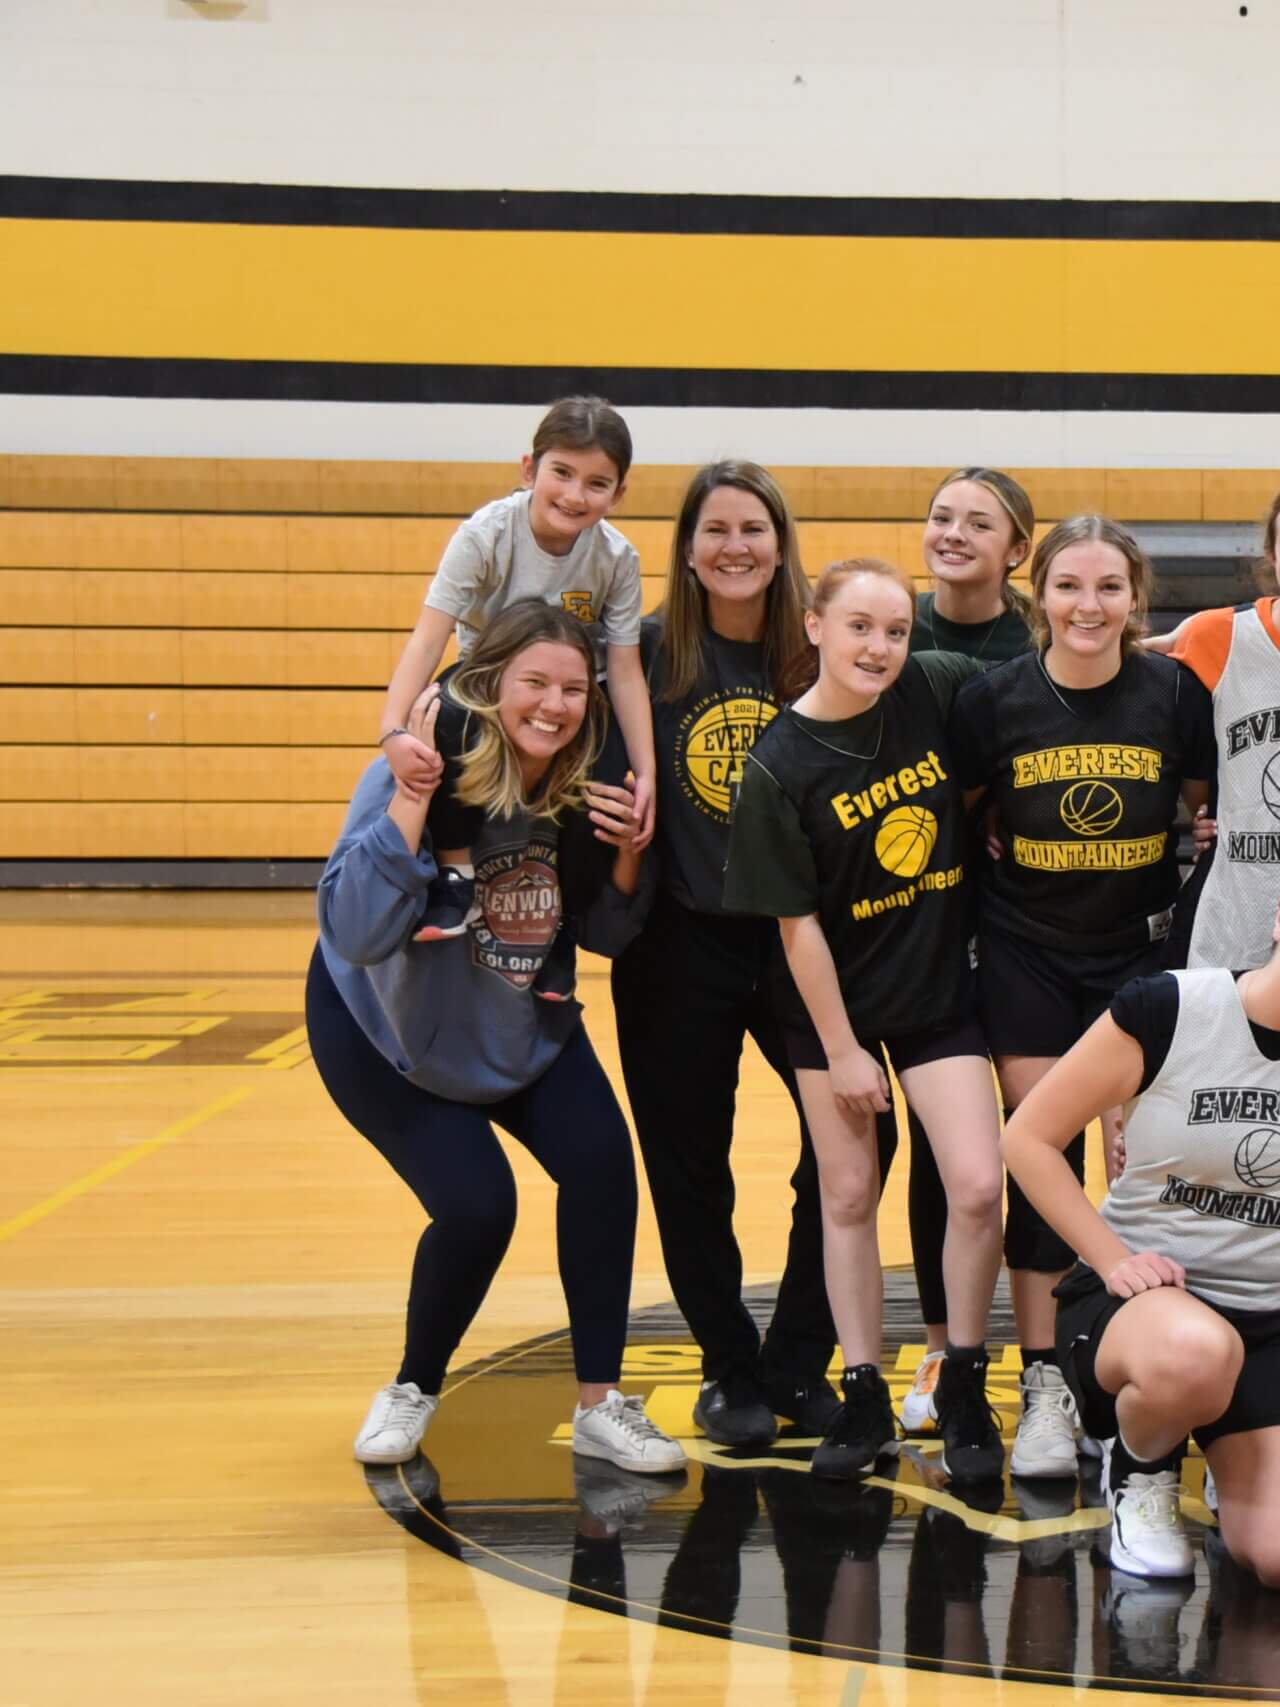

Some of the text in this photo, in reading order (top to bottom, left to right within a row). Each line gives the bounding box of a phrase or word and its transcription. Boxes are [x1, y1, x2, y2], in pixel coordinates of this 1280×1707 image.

[733, 703, 756, 713] 2021
[704, 723, 760, 752] EVER
[709, 758, 746, 787] CA
[1012, 744, 1163, 788] EVEREST
[831, 750, 948, 830] Everest
[1013, 832, 1168, 871] MOUNTAINEERS
